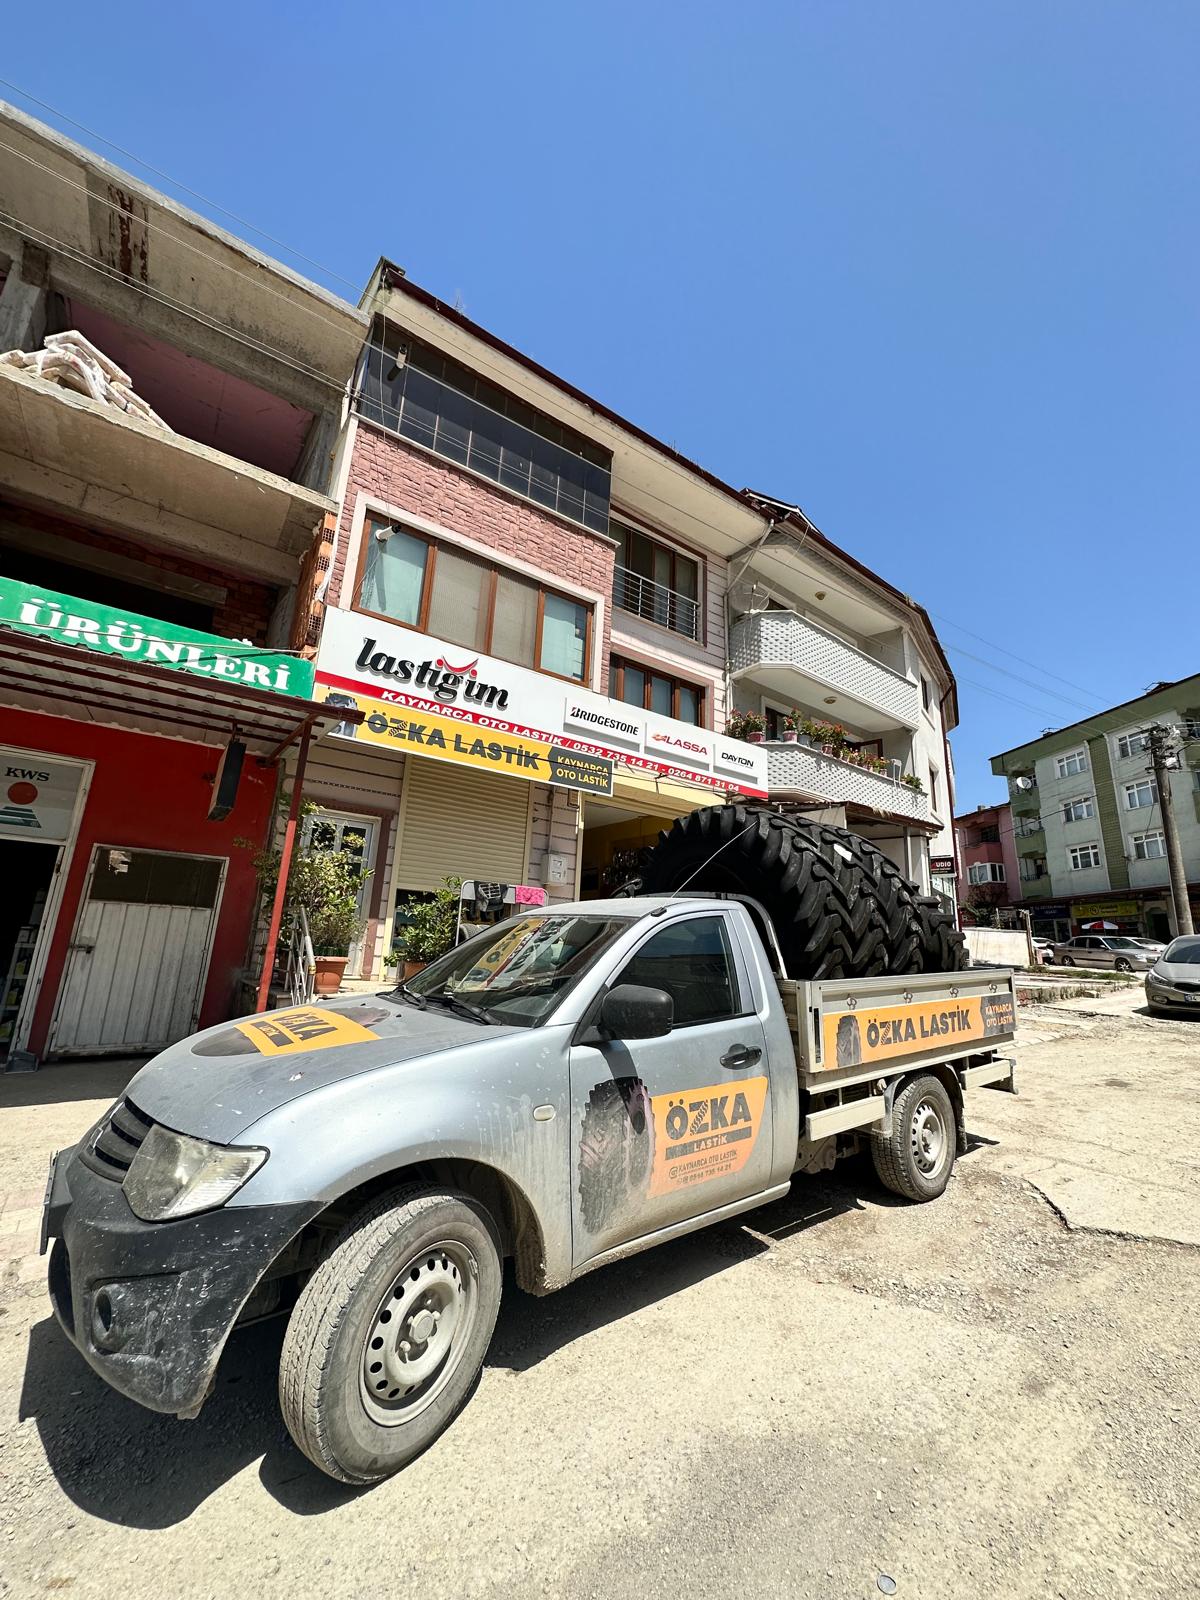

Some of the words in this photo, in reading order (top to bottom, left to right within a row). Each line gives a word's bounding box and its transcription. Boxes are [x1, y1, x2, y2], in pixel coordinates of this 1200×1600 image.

[20, 598, 290, 690] ÜRÜNLERİ
[570, 707, 639, 736] BRIDGESTONE
[367, 708, 447, 750] ÖZKA
[453, 733, 540, 771] LASTİK
[381, 690, 473, 722] KAYNARCA
[478, 716, 509, 732] OTO
[513, 723, 563, 746] LASTİK
[572, 741, 603, 758] 0532
[606, 750, 627, 763] 735
[630, 756, 644, 767] 14
[646, 761, 660, 771] 21
[668, 766, 693, 780] 0264
[694, 773, 713, 785] 871
[715, 779, 726, 790] 31
[728, 782, 740, 793] 04
[664, 735, 708, 756] LASSA
[556, 755, 609, 777] KAYNARCA
[721, 752, 754, 768] DAYTON
[4, 766, 50, 782] KWS
[556, 767, 576, 780] OTO
[577, 771, 609, 789] LASTİK
[866, 1014, 917, 1048] ÖZKA
[919, 1005, 972, 1038] LASTİK
[986, 1017, 997, 1027] OTO
[665, 1092, 752, 1140] ÖZKA
[693, 1134, 728, 1152] LASTİK
